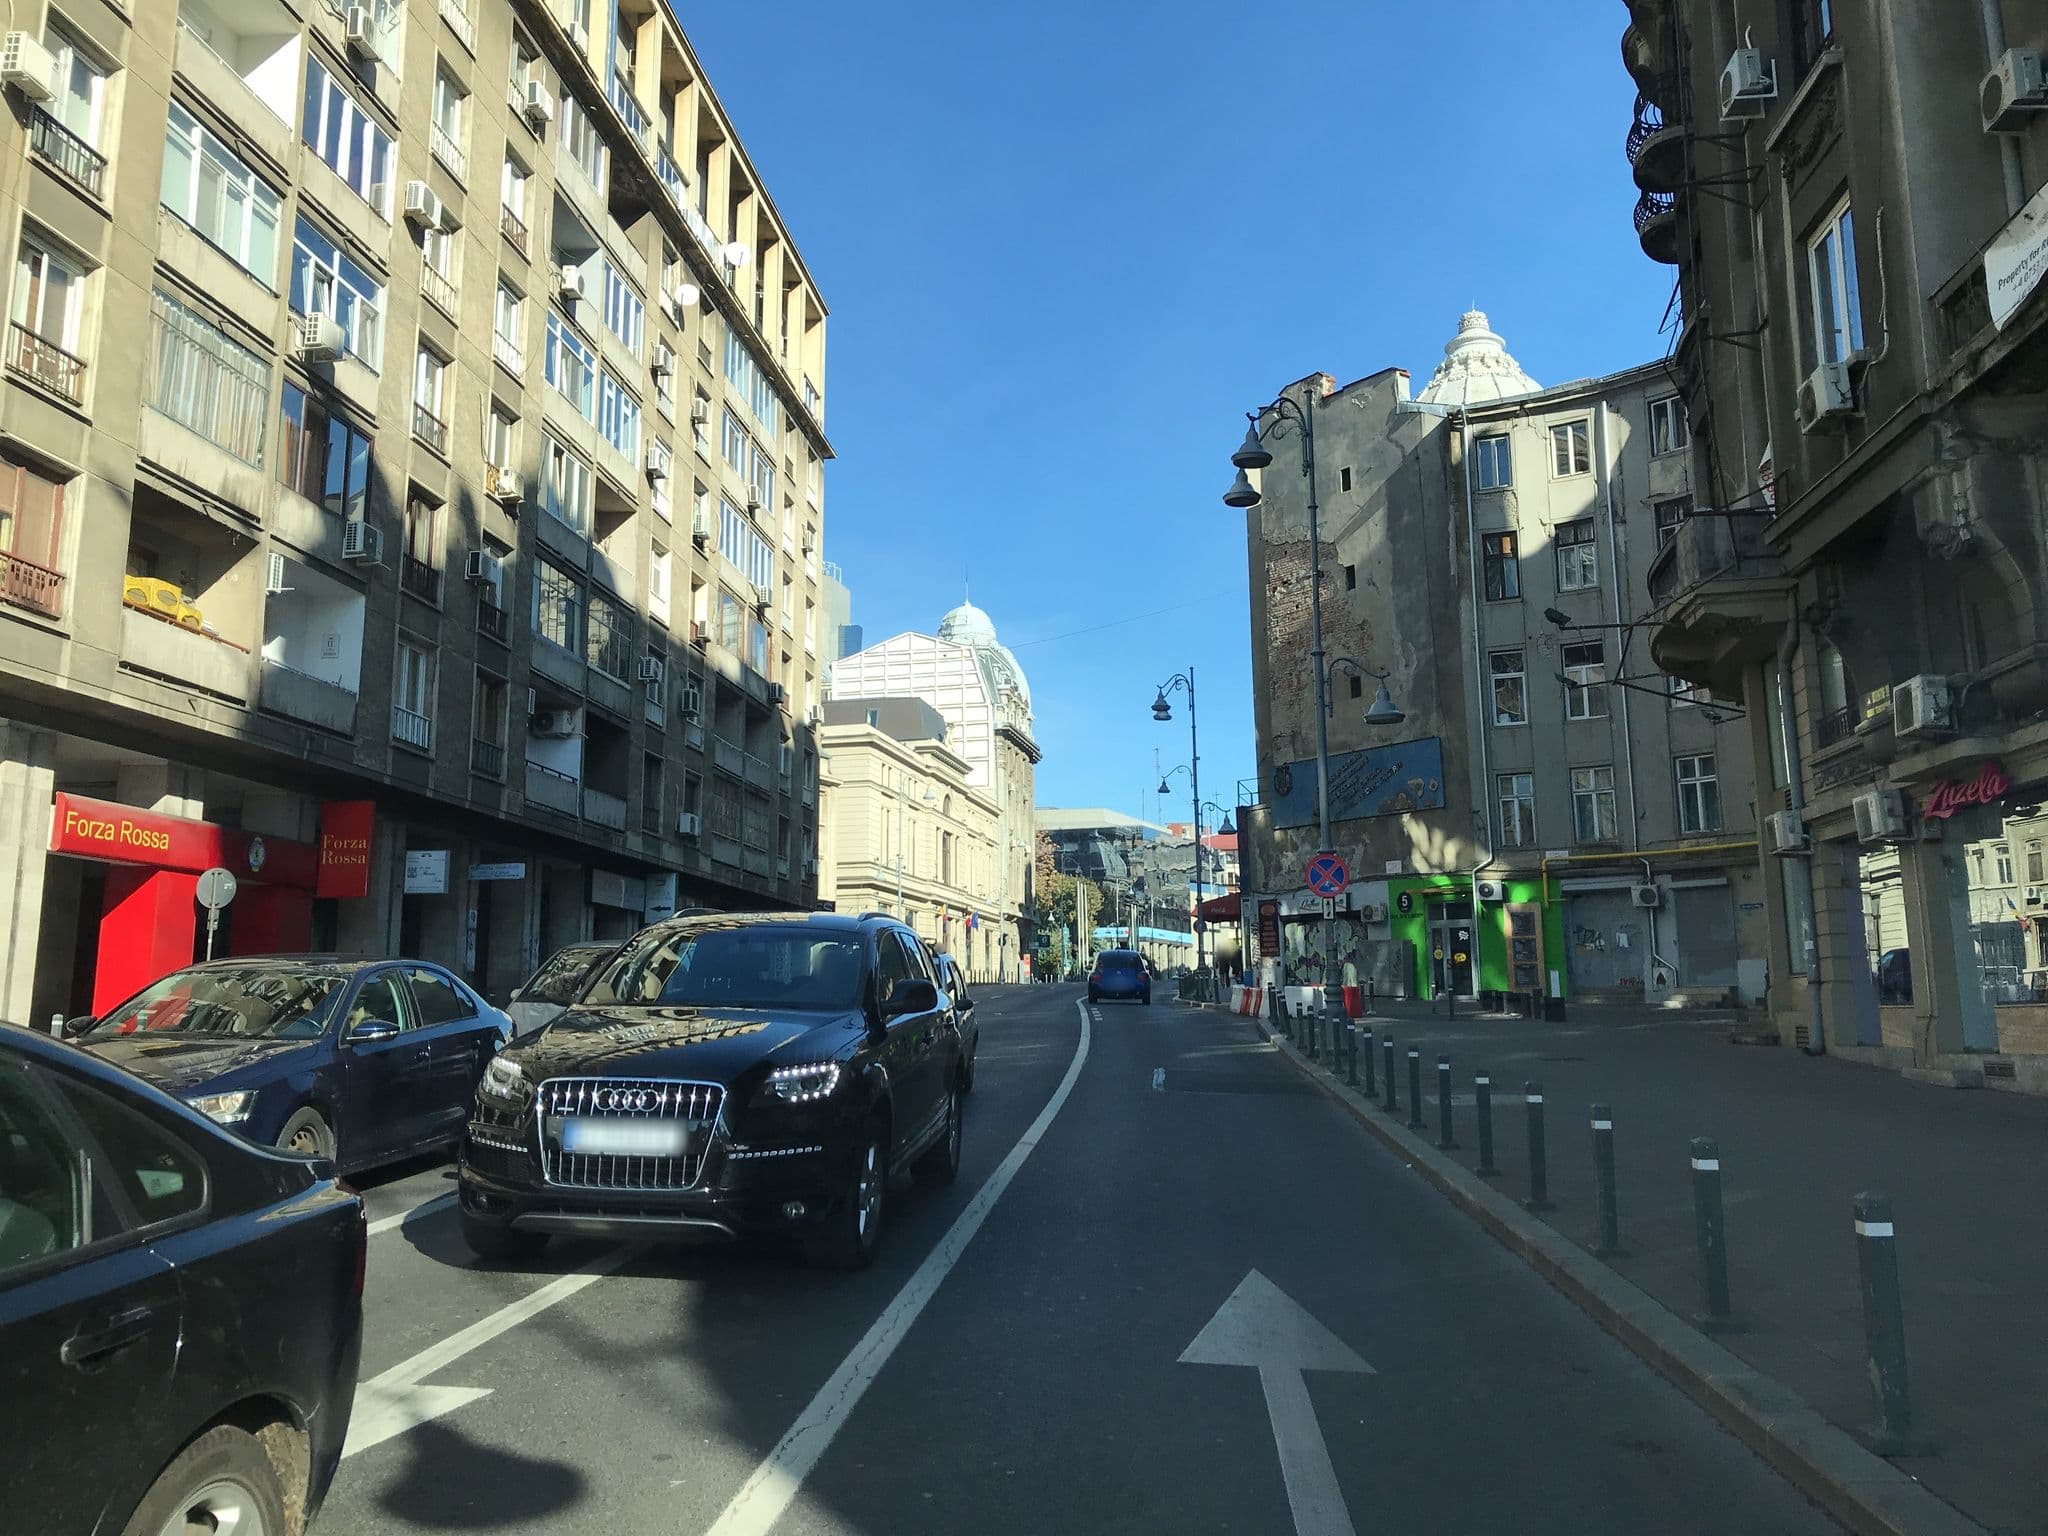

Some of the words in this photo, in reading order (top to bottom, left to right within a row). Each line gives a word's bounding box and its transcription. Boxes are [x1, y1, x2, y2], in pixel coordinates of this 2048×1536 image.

[1998, 257, 2028, 291] Property
[2029, 246, 2041, 263] for
[65, 811, 115, 841] Forza
[120, 820, 170, 850] Rossa
[323, 833, 367, 849] Forza
[322, 850, 367, 865] Rossa
[1401, 895, 1408, 907] 5
